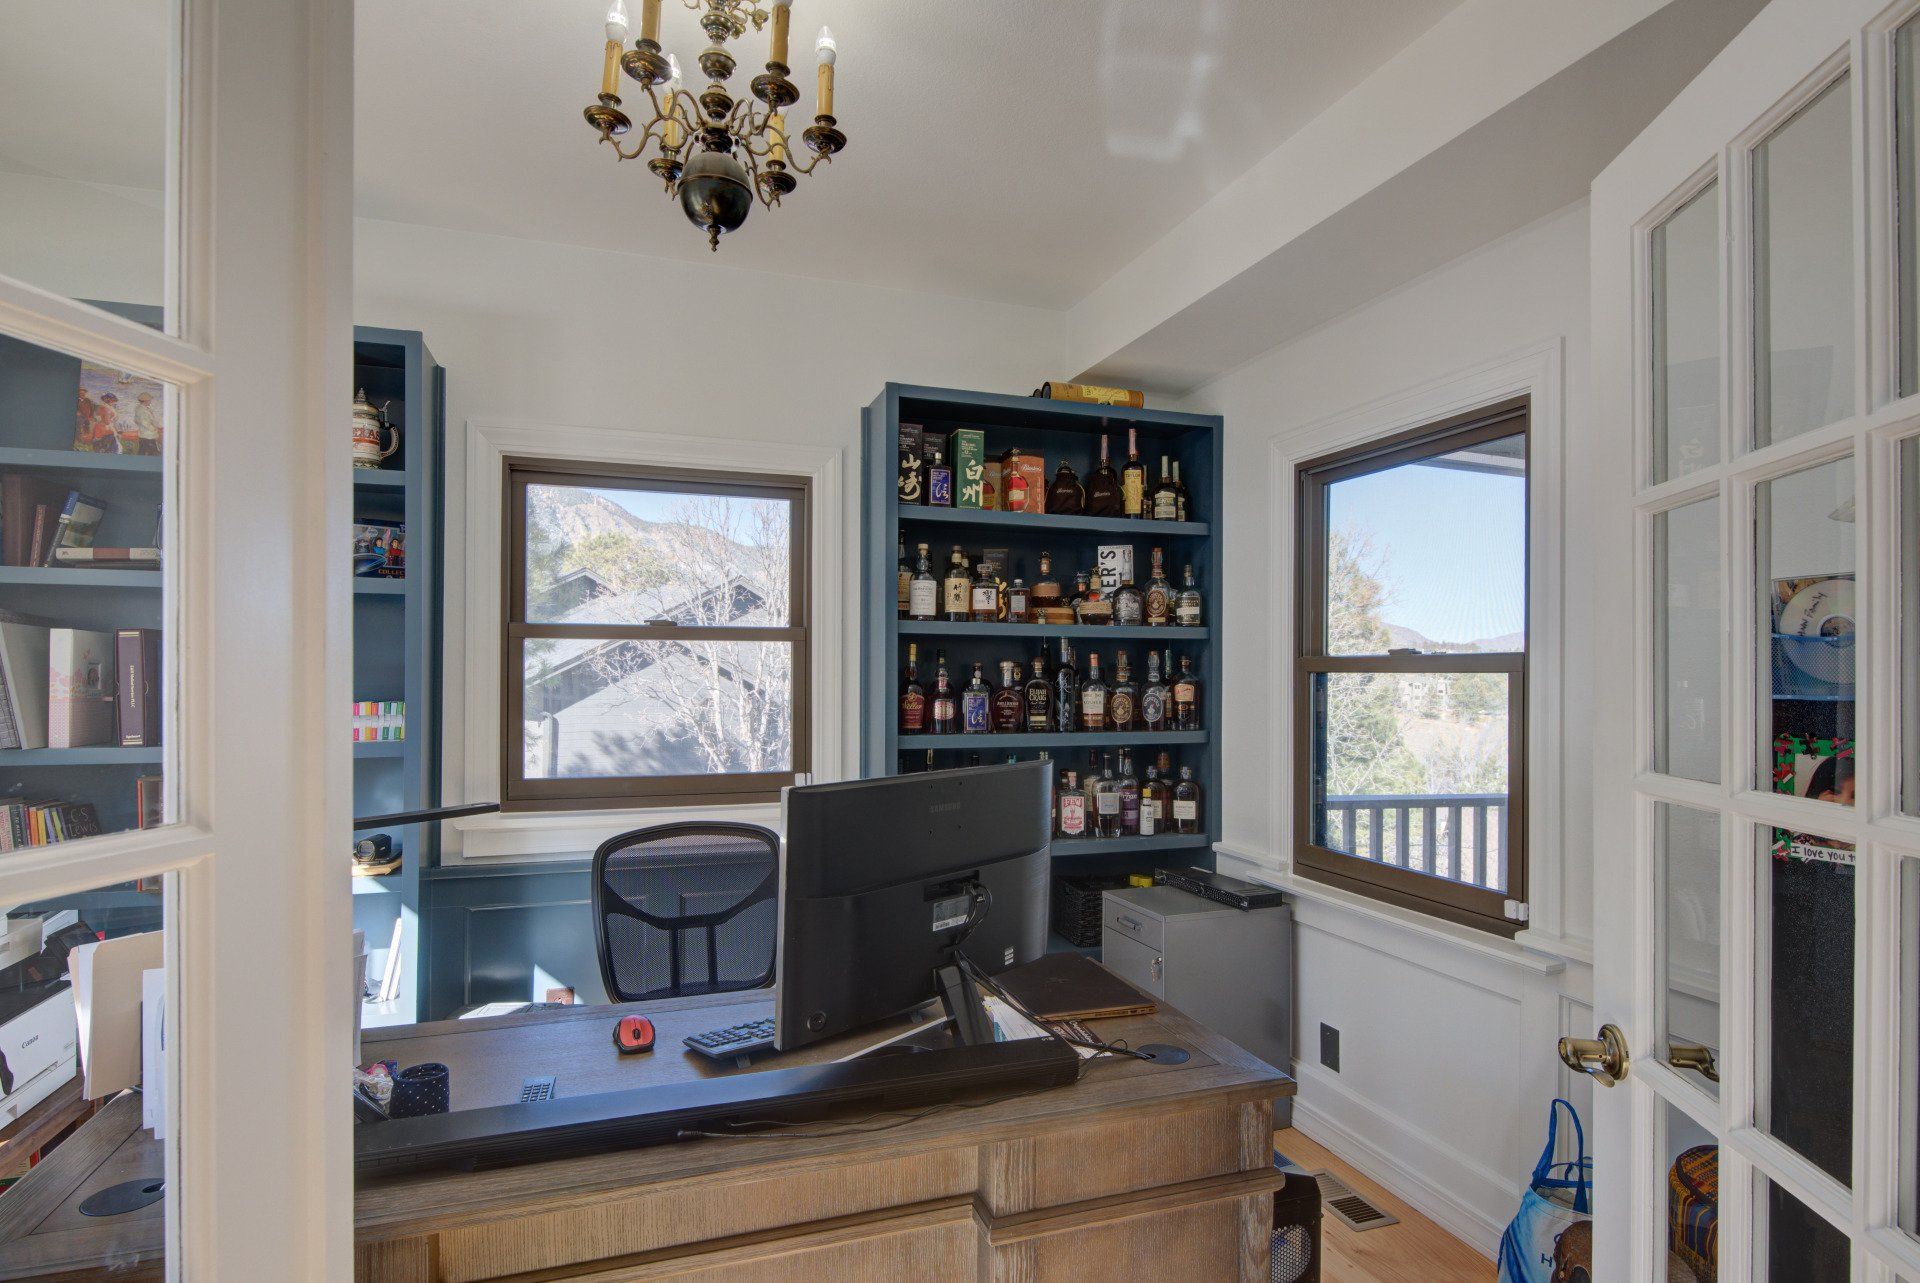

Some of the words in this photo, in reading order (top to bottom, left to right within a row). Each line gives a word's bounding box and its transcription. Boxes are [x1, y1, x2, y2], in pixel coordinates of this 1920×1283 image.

[963, 460, 984, 506] 白州
[929, 802, 961, 813] SAMSUNG
[1063, 797, 1083, 808] FEW
[1804, 847, 1824, 859] love
[1828, 851, 1846, 863] you
[22, 1034, 39, 1049] Canon
